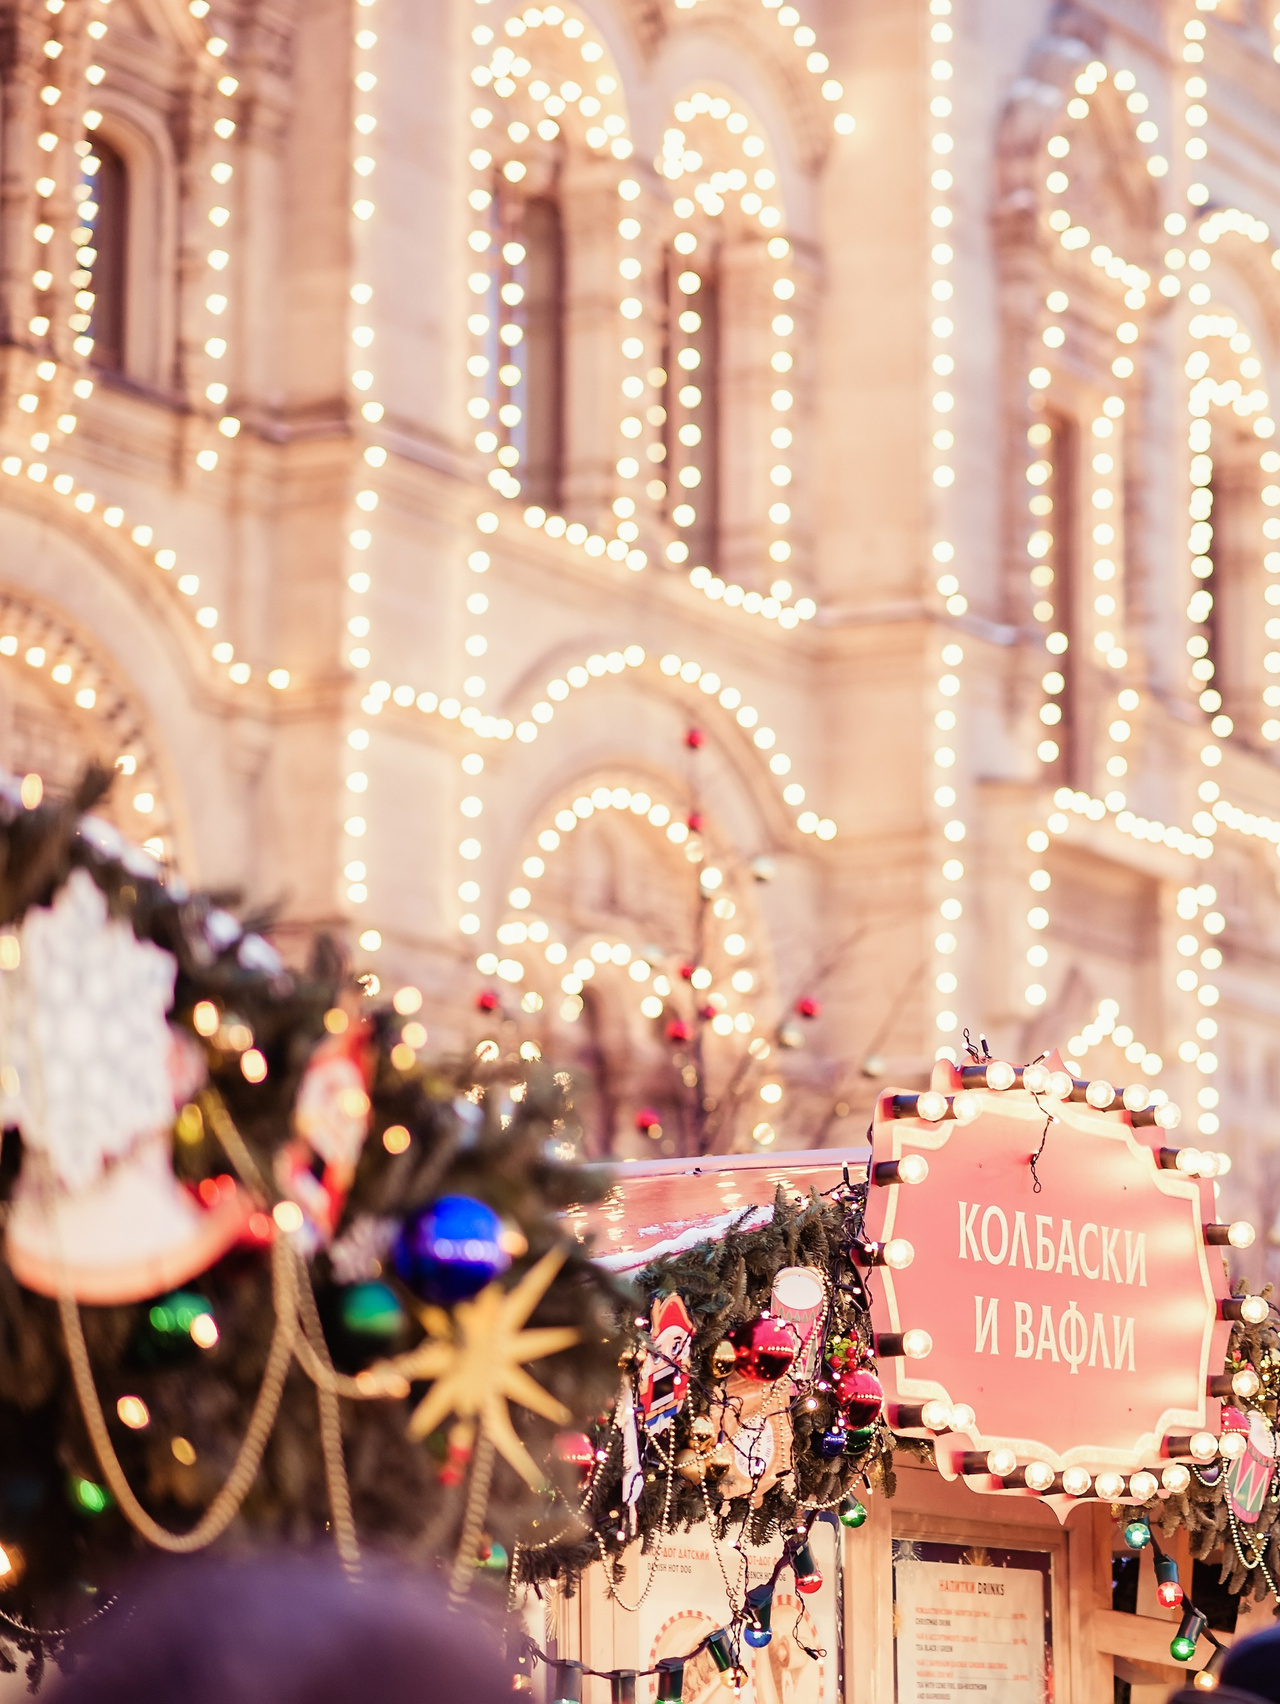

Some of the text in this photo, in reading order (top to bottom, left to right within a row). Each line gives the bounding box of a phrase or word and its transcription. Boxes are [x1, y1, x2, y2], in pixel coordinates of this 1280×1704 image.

[957, 1200, 1148, 1287] КОЛБАСКИ
[974, 1295, 1136, 1374] И ВАФЛИ
[678, 1548, 710, 1561] ДАТСКИЙ
[746, 1555, 771, 1566] ОТ-ДОГ
[668, 1564, 679, 1573] HOT
[680, 1565, 692, 1574] DOG
[746, 1570, 763, 1580] RENCH
[978, 1582, 1004, 1595] DRINKS
